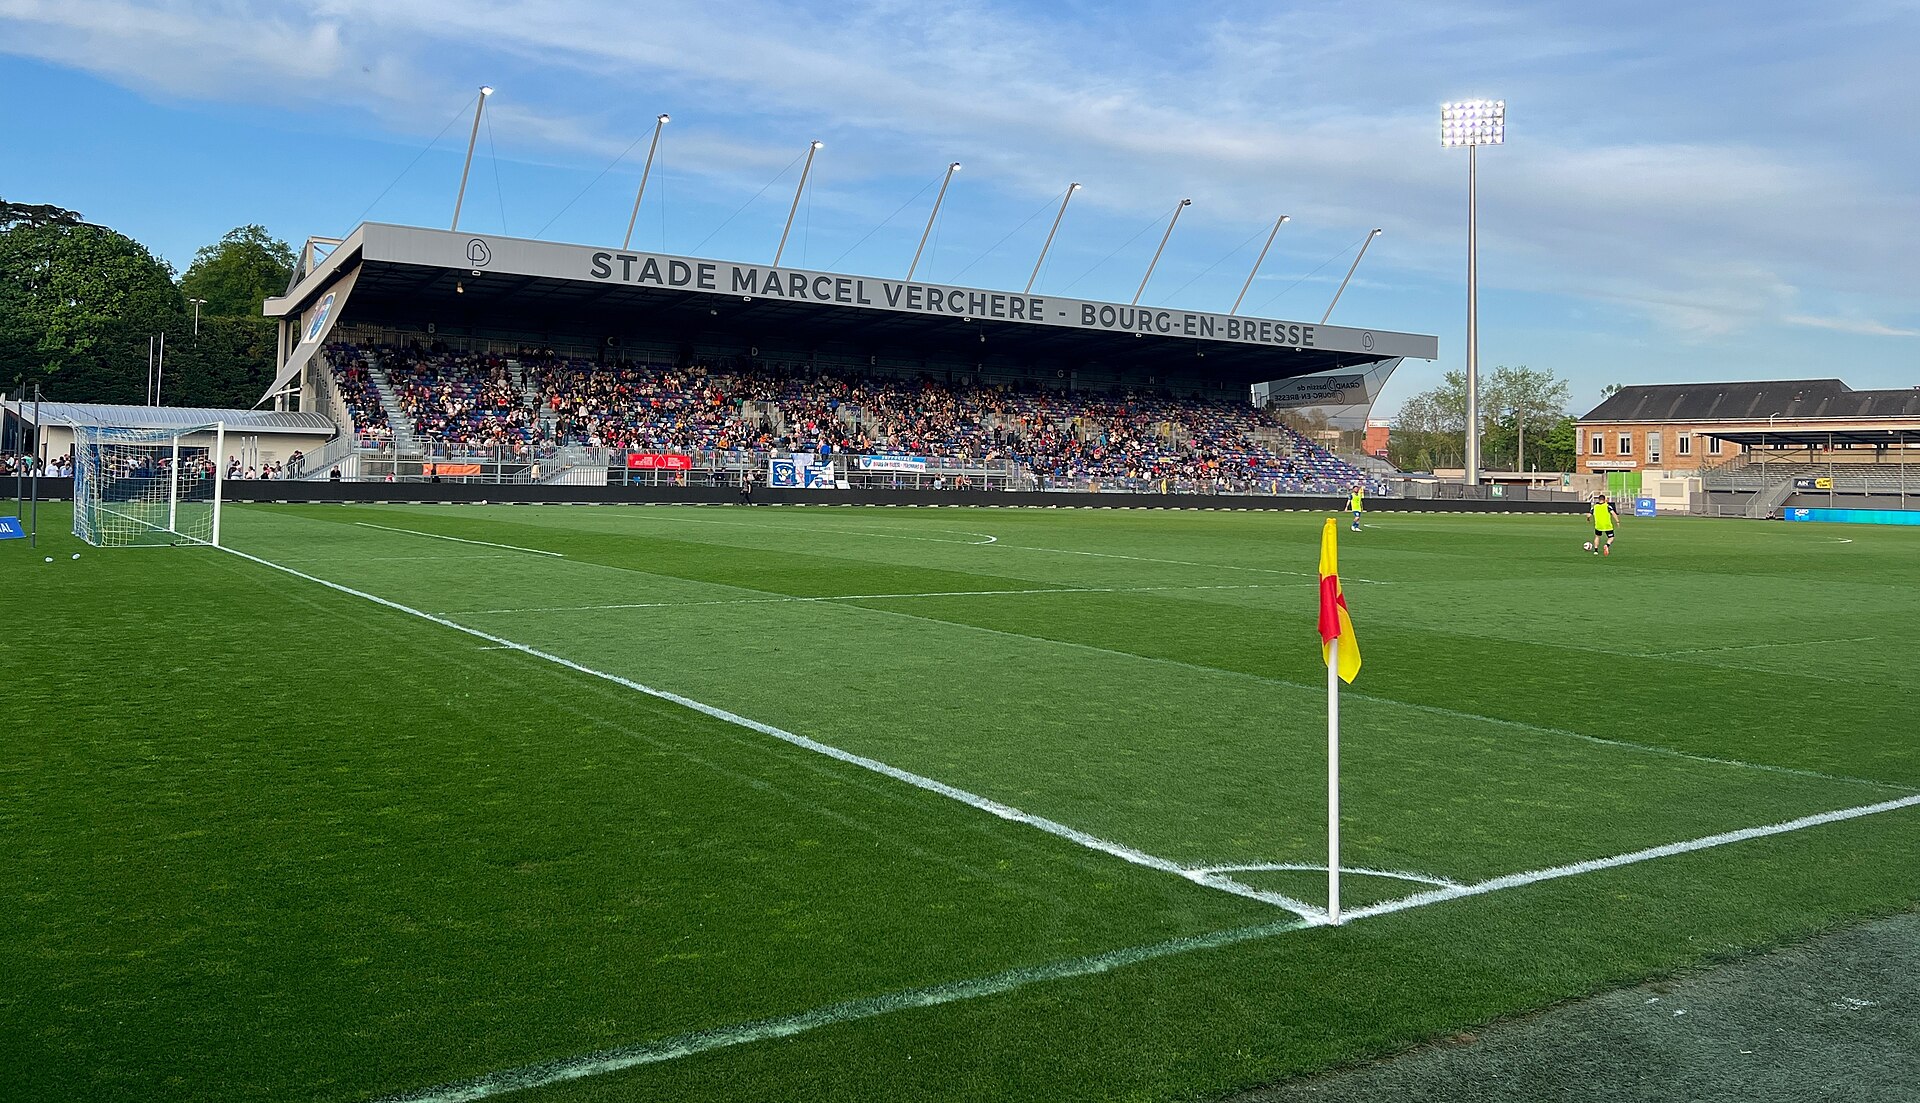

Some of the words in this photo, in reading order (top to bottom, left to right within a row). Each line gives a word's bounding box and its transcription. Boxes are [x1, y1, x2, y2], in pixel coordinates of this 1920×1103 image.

[590, 252, 716, 290] STADE
[732, 266, 871, 305] MARCEL
[883, 283, 1044, 321] VERCHERE
[1081, 303, 1315, 347] BOURG-EN-BRESSE
[428, 323, 435, 333] B
[607, 337, 614, 346] C
[751, 347, 758, 356] D
[871, 356, 876, 365] E
[977, 364, 982, 372] F
[1057, 369, 1064, 378] G
[1149, 376, 1155, 384] H
